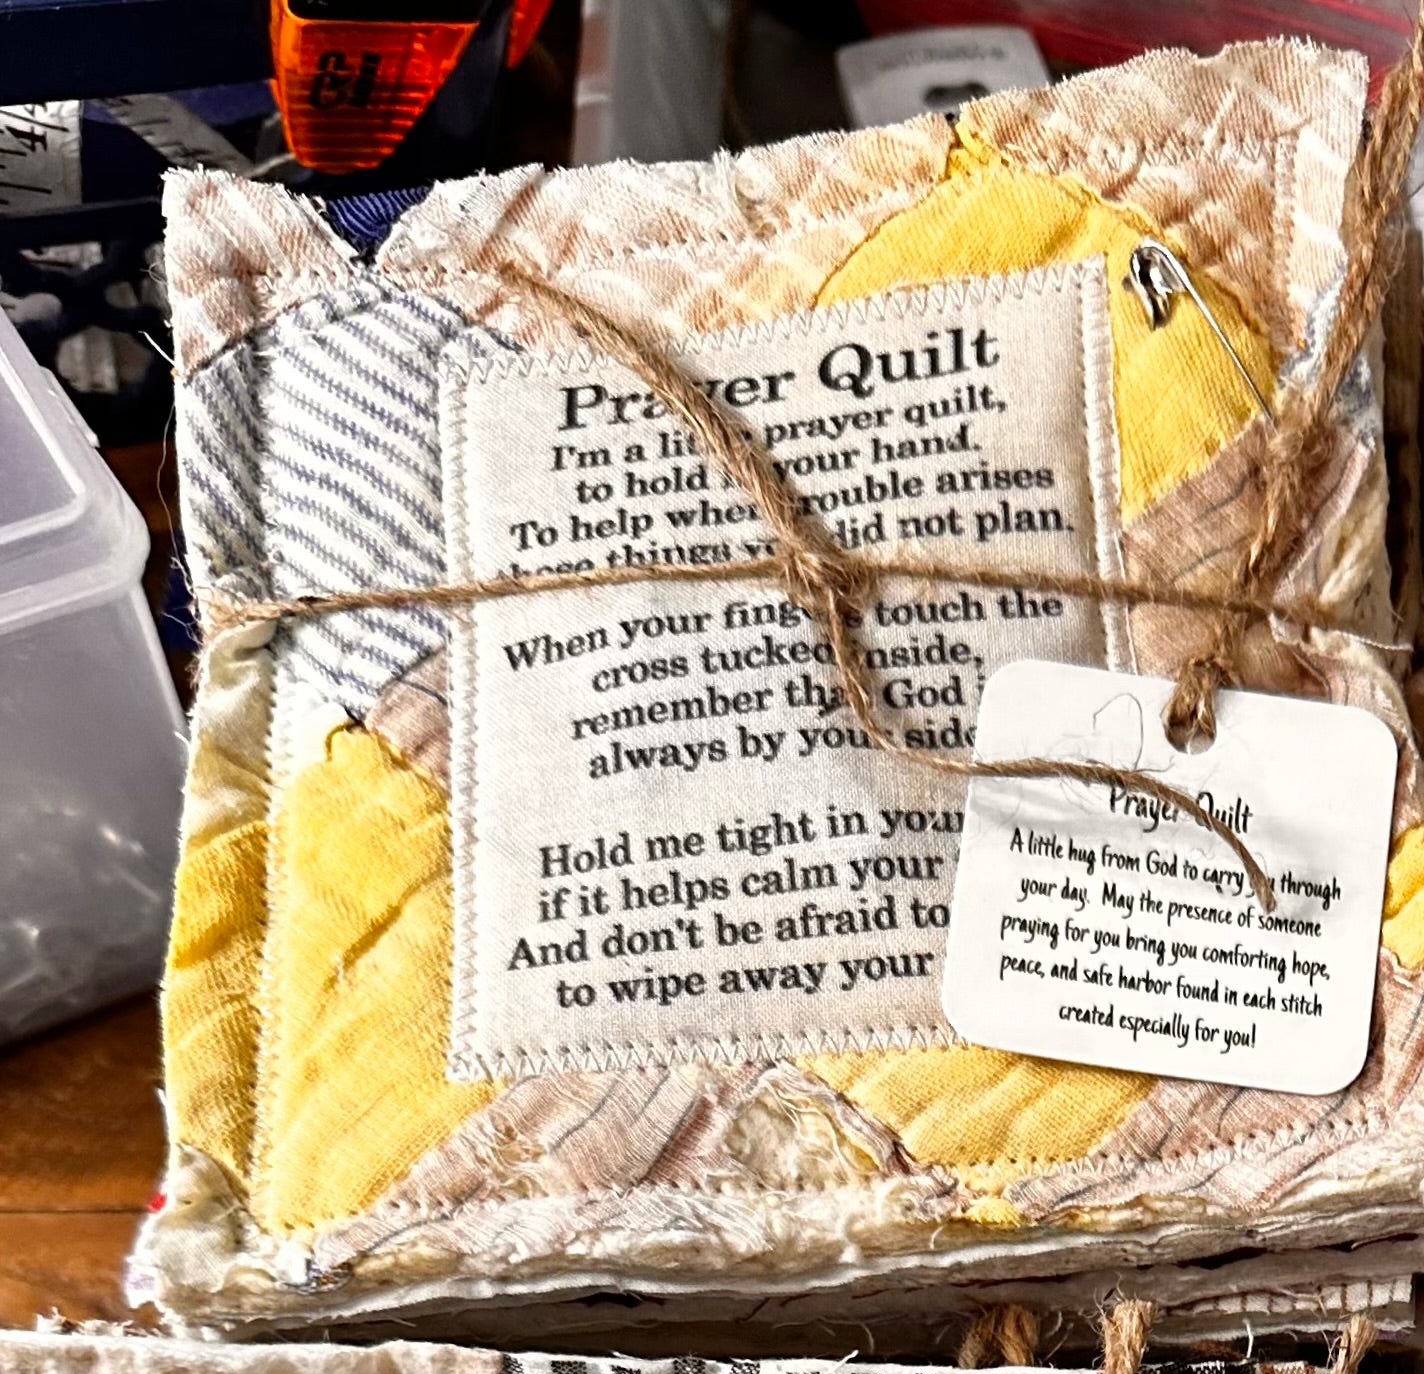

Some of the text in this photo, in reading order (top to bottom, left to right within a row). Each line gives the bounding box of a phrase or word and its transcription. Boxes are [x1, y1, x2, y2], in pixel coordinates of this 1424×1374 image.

[817, 327, 1000, 400] Quilt
[764, 384, 1007, 449] prayer quilt,
[538, 853, 945, 923] if it helps calm your
[507, 893, 899, 971] And don't be afraid
[1000, 915, 1330, 988] praying for you bring you comforting hope,
[556, 951, 935, 1009] to wipe away your
[999, 954, 1323, 1017] peace, and safe harbor found in each stitch
[1058, 1004, 1257, 1055] created especially for you!
